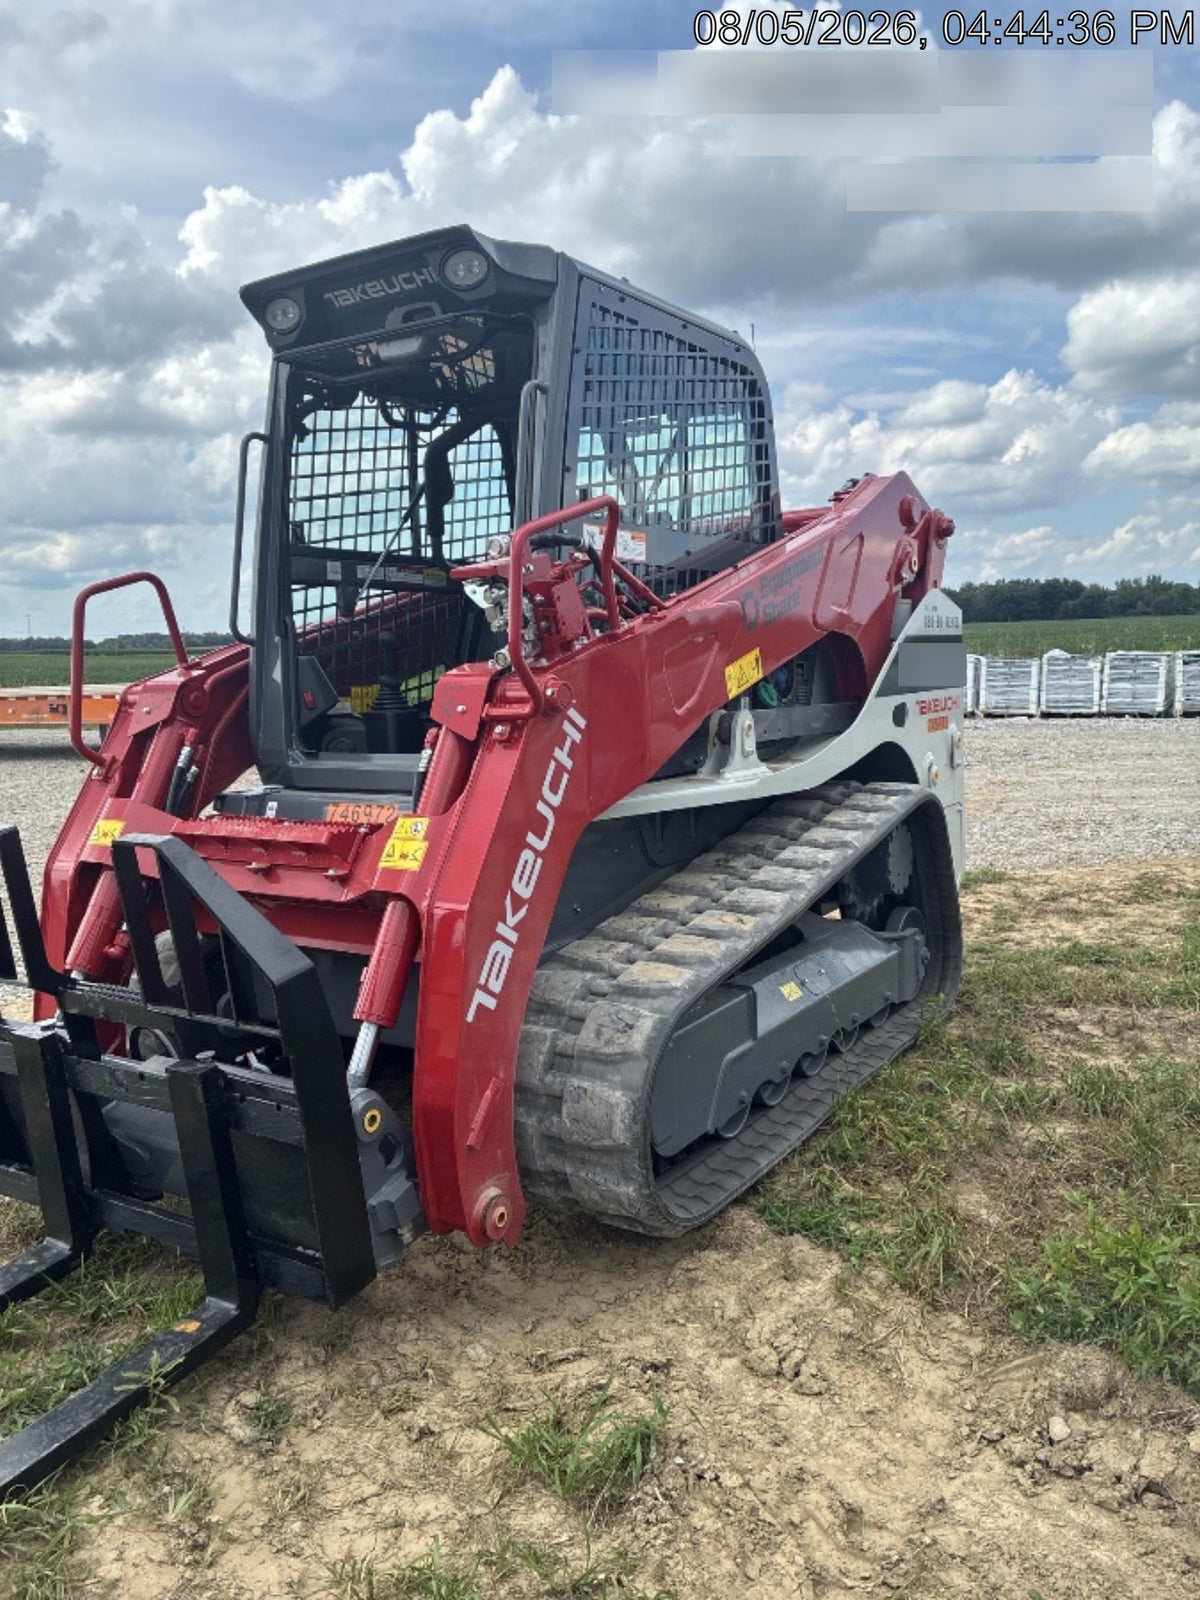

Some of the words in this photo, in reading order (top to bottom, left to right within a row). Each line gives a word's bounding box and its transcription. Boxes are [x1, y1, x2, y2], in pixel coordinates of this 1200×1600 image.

[323, 266, 438, 307] TAKEUCHI
[328, 803, 396, 824] 746972
[465, 706, 587, 1023] TAKEUCHI
